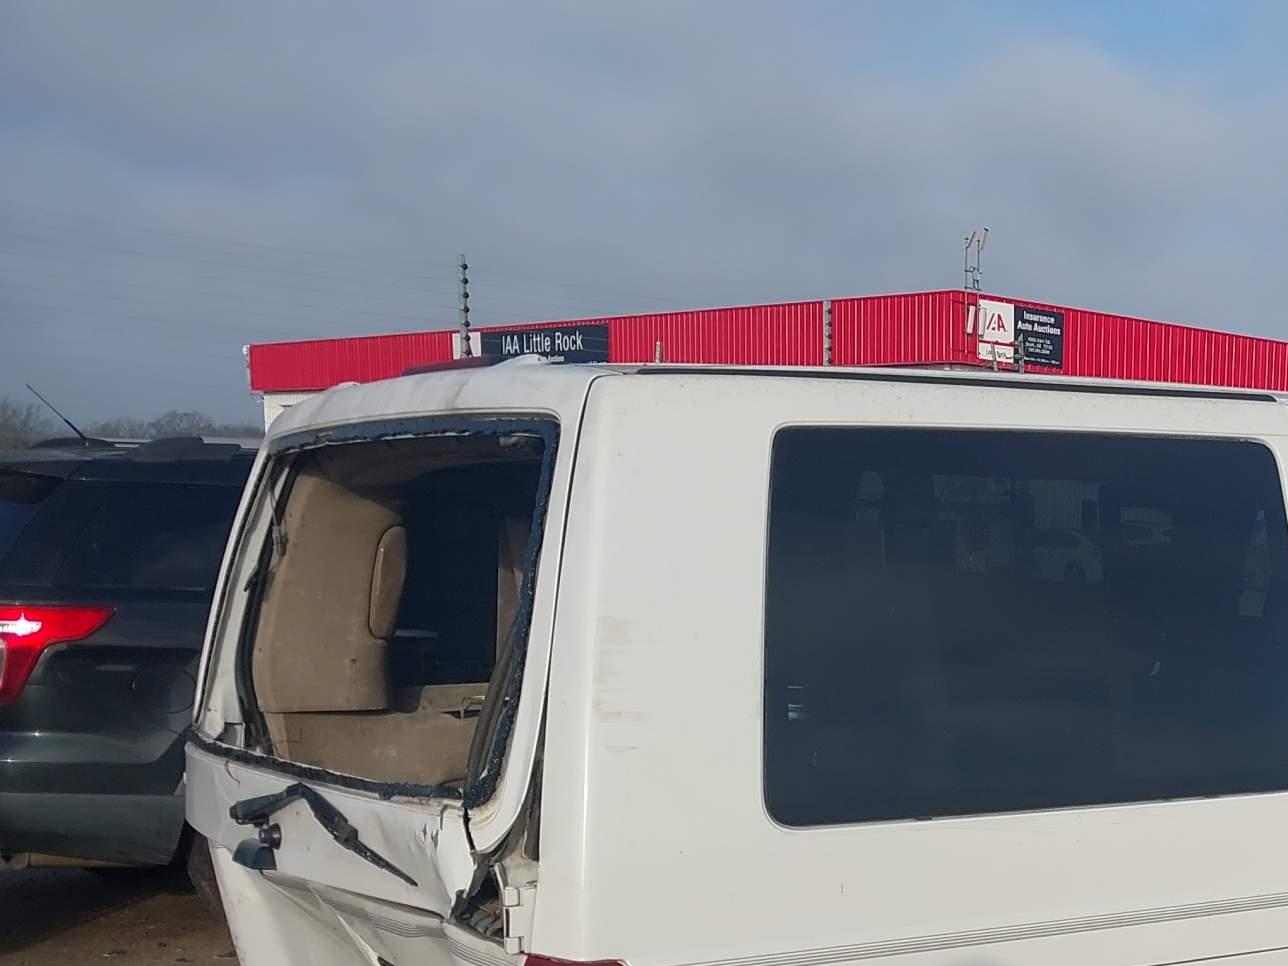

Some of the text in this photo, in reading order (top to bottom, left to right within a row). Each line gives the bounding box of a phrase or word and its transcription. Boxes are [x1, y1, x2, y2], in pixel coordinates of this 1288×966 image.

[1023, 310, 1055, 324] Insurance
[1016, 320, 1061, 336] Auto Auctions
[502, 328, 584, 354] IAA Little Rock
